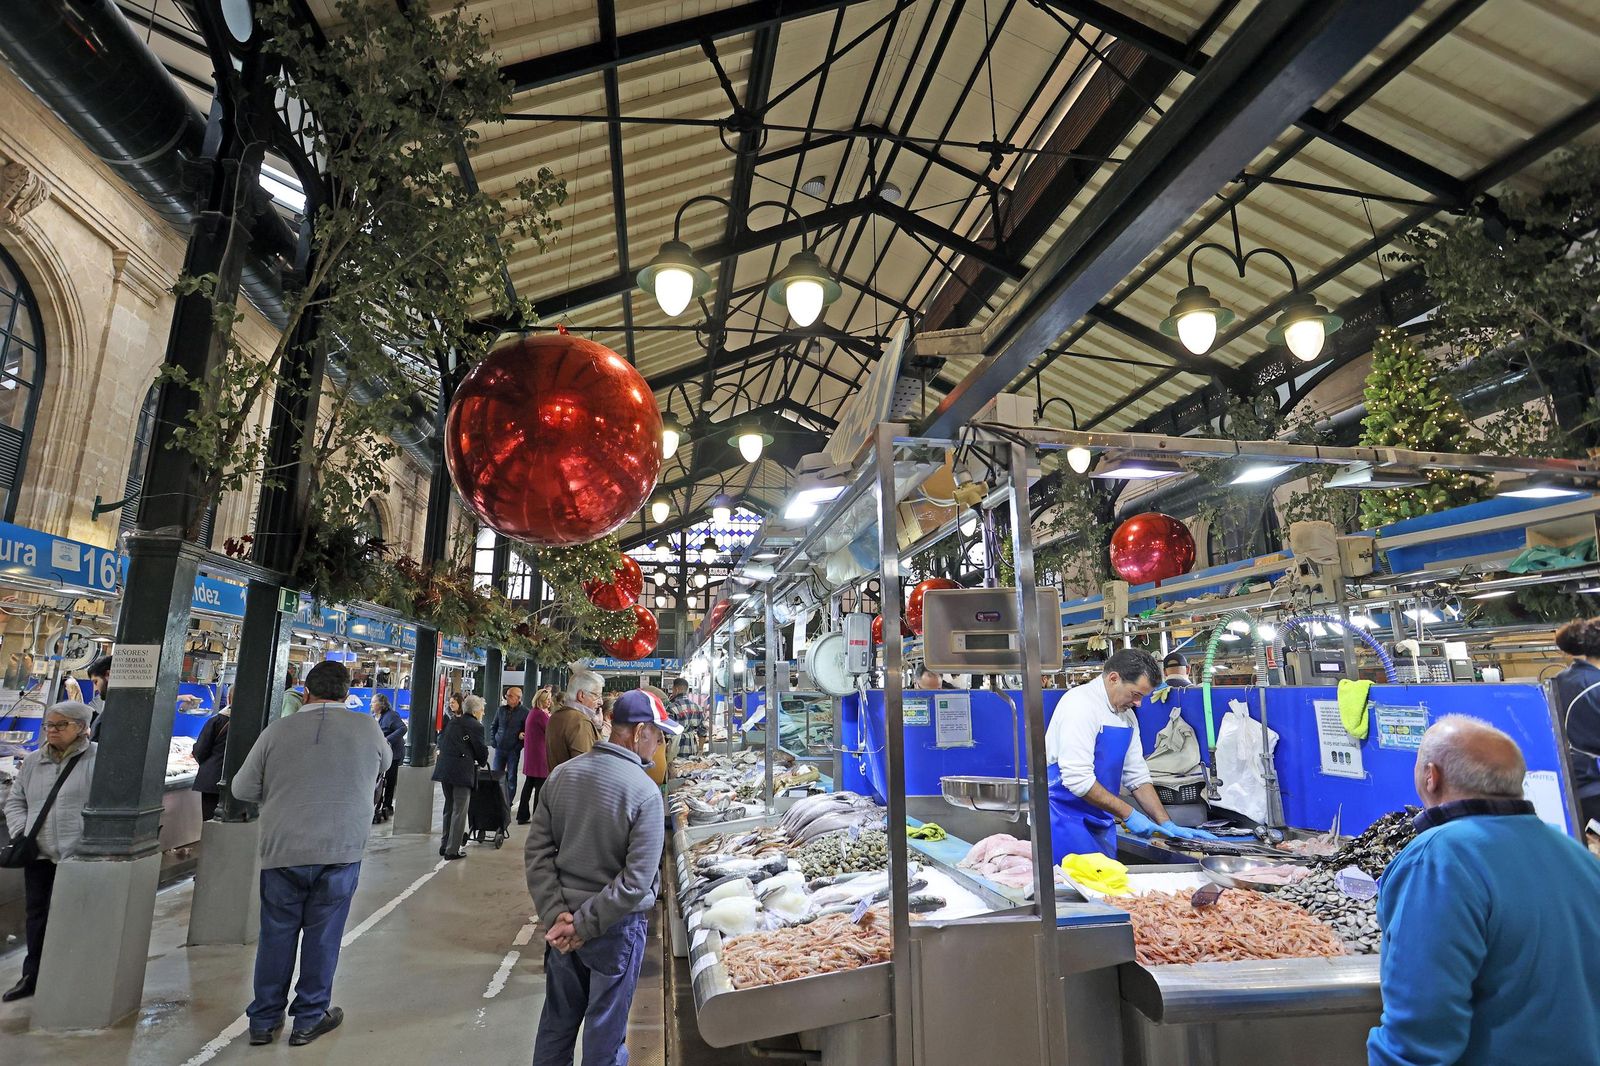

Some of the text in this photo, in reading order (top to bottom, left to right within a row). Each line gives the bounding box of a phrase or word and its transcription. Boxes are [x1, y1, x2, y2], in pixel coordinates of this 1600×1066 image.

[84, 547, 116, 589] 16
[335, 612, 346, 635] 18
[665, 659, 679, 669] 24
